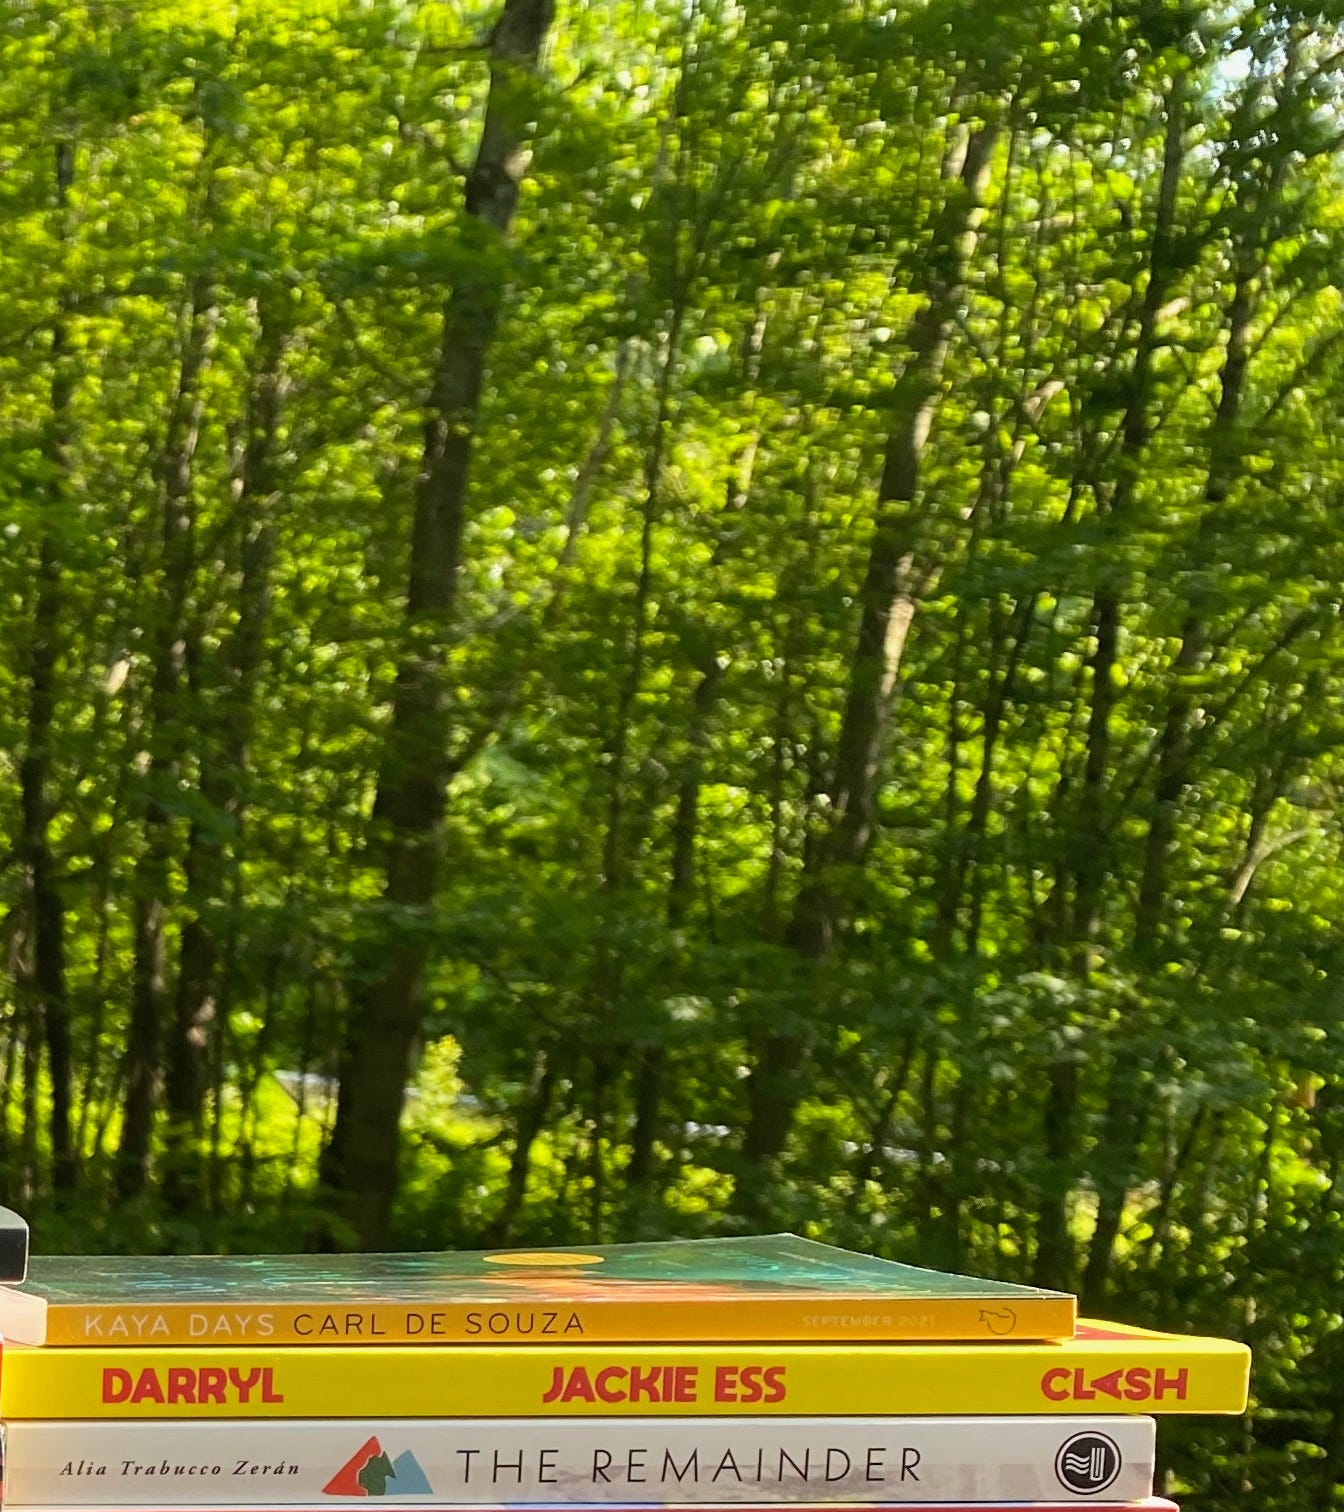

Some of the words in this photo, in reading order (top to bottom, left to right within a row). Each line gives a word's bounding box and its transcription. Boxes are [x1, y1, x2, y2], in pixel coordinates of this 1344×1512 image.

[84, 1313, 170, 1337] KAYA
[189, 1313, 275, 1336] DAYS
[293, 1313, 387, 1336] CARL
[405, 1313, 446, 1335] DE
[464, 1312, 585, 1334] SOUZA
[102, 1367, 283, 1404] DARRYL
[542, 1367, 697, 1403] JACKIE
[714, 1366, 787, 1403] ESS
[60, 1459, 110, 1476] Alia
[120, 1459, 223, 1476] Trabucco
[232, 1459, 301, 1476] Zerán
[456, 1449, 560, 1484] THE
[593, 1449, 922, 1483] REMAINDER
